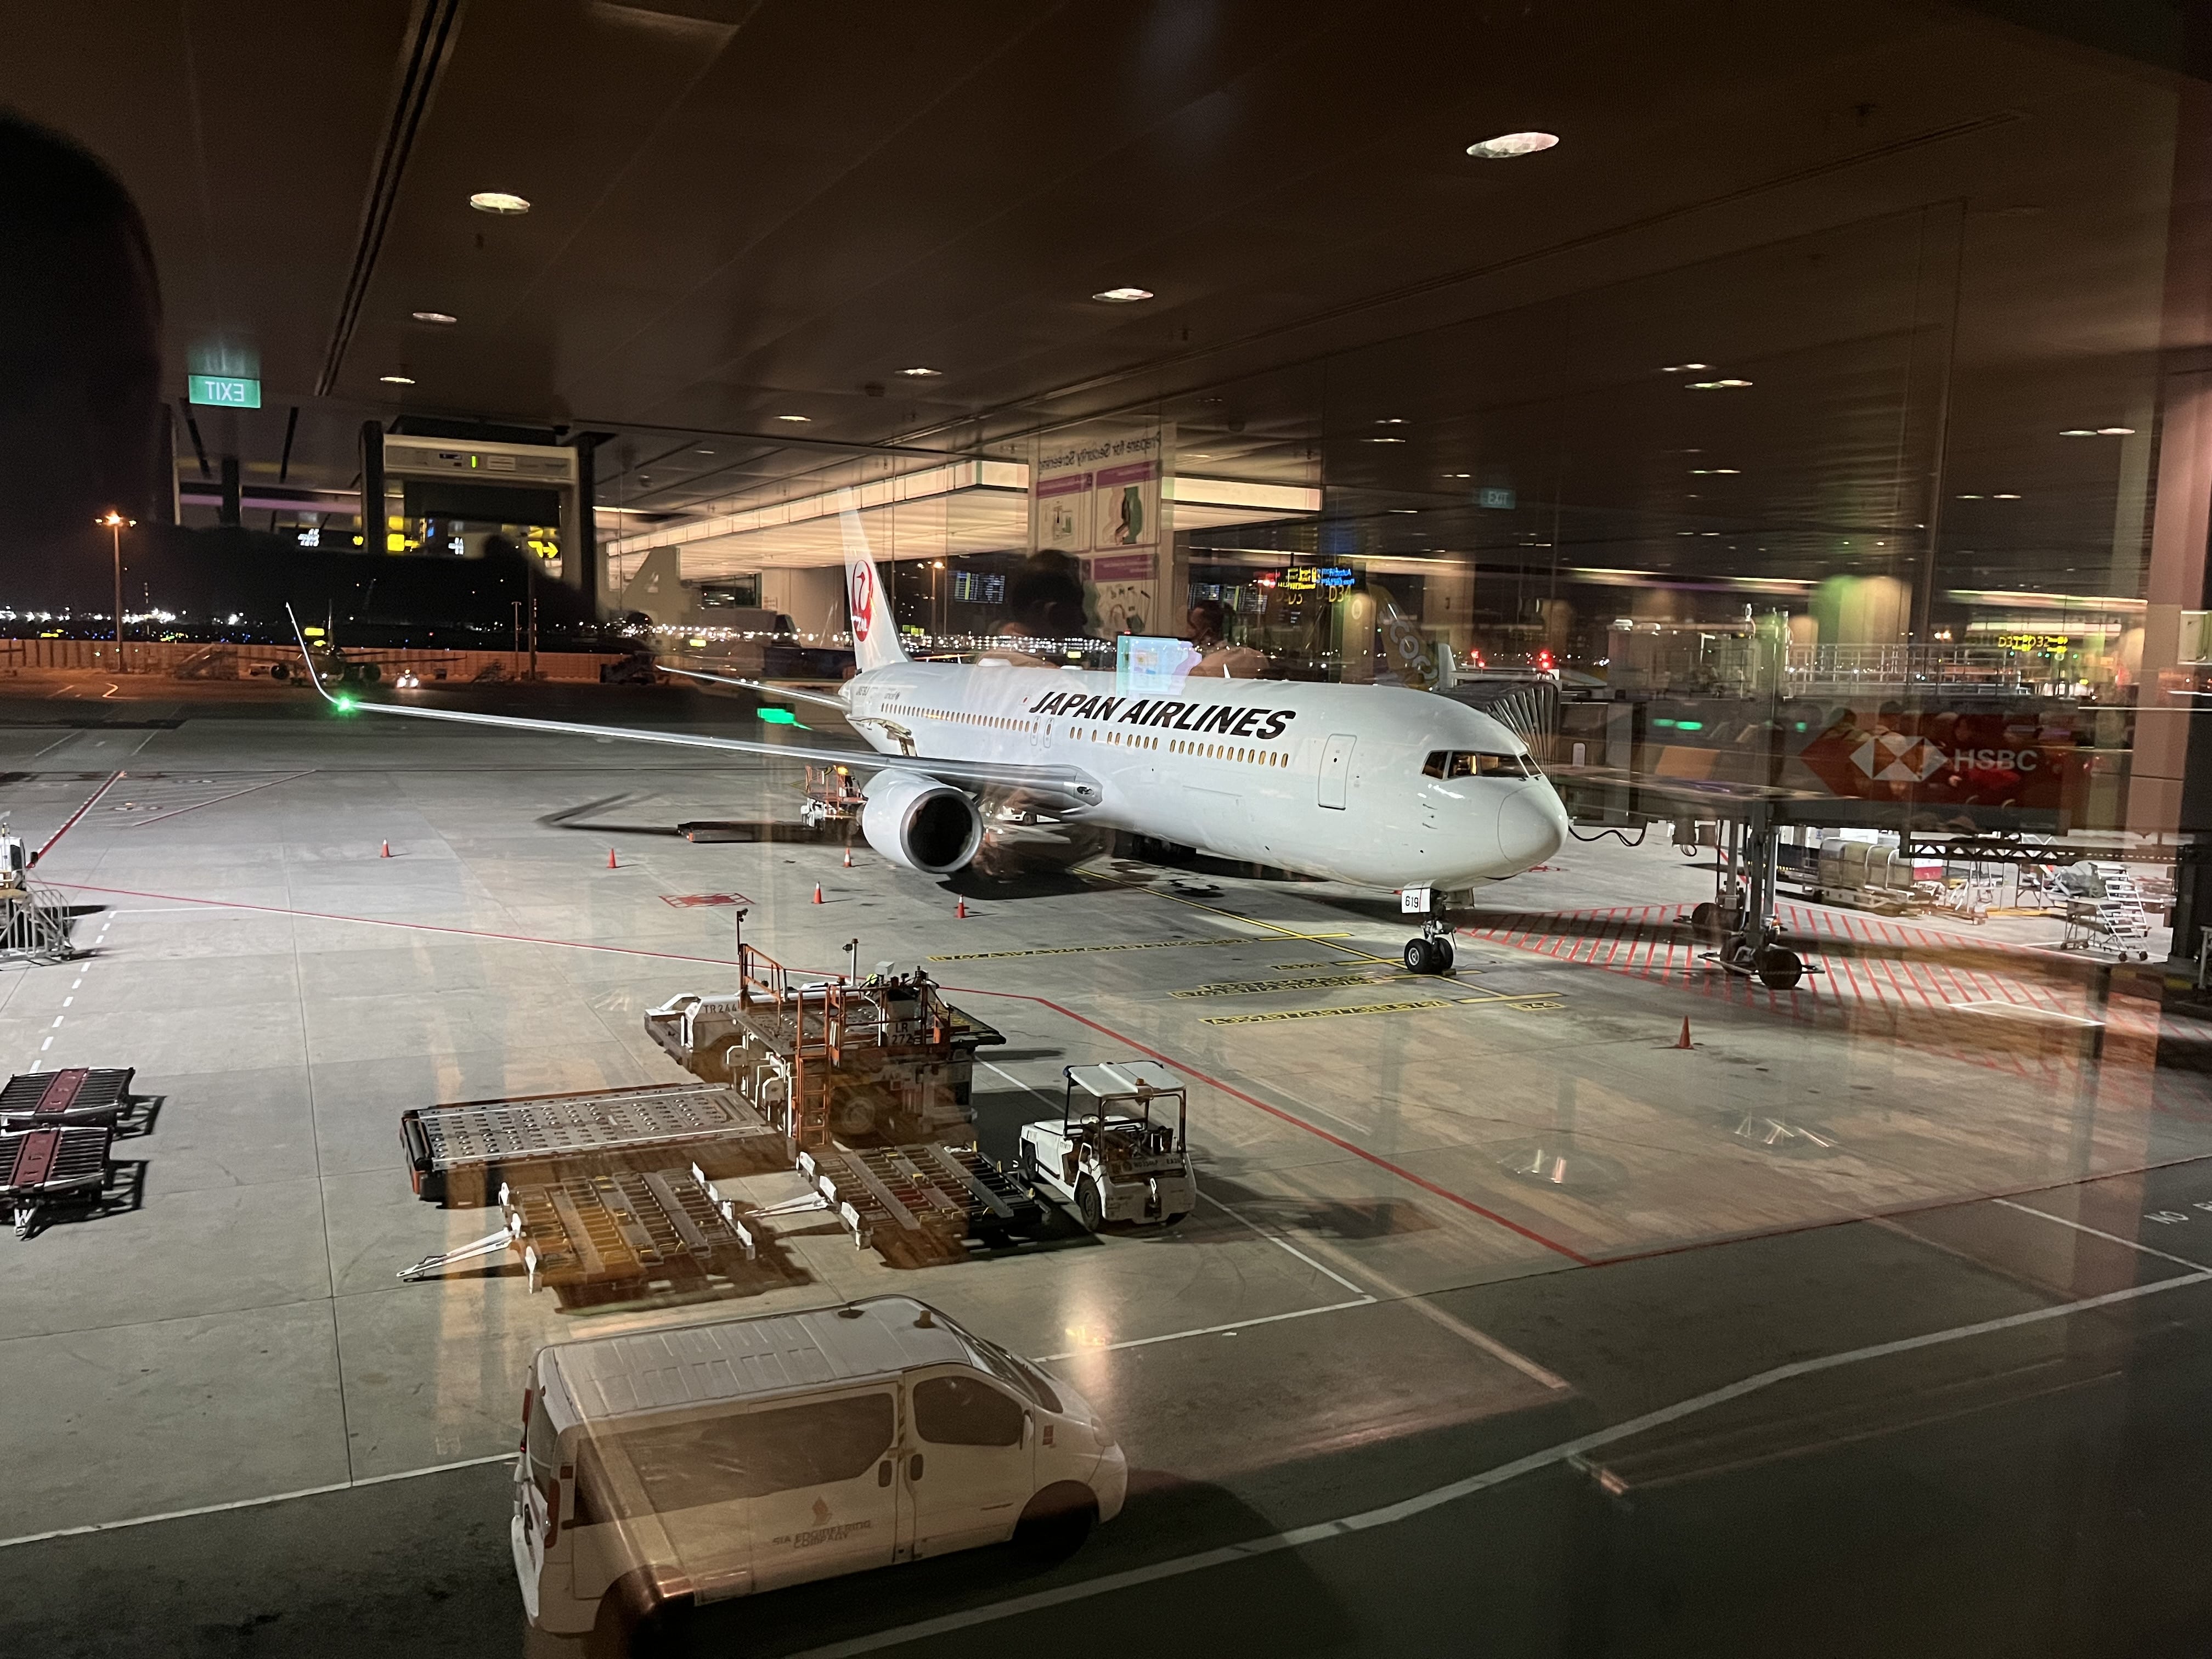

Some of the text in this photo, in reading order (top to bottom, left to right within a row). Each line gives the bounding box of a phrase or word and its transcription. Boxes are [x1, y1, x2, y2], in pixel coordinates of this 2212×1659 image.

[1487, 490, 1509, 505] EXIT
[1030, 691, 1297, 740] JAPAN AIRLINES
[1954, 748, 2038, 771] HSBC
[1406, 896, 1419, 908] 619
[895, 1022, 909, 1033] LR
[2143, 1211, 2189, 1224] NO
[772, 1536, 791, 1545] SIA
